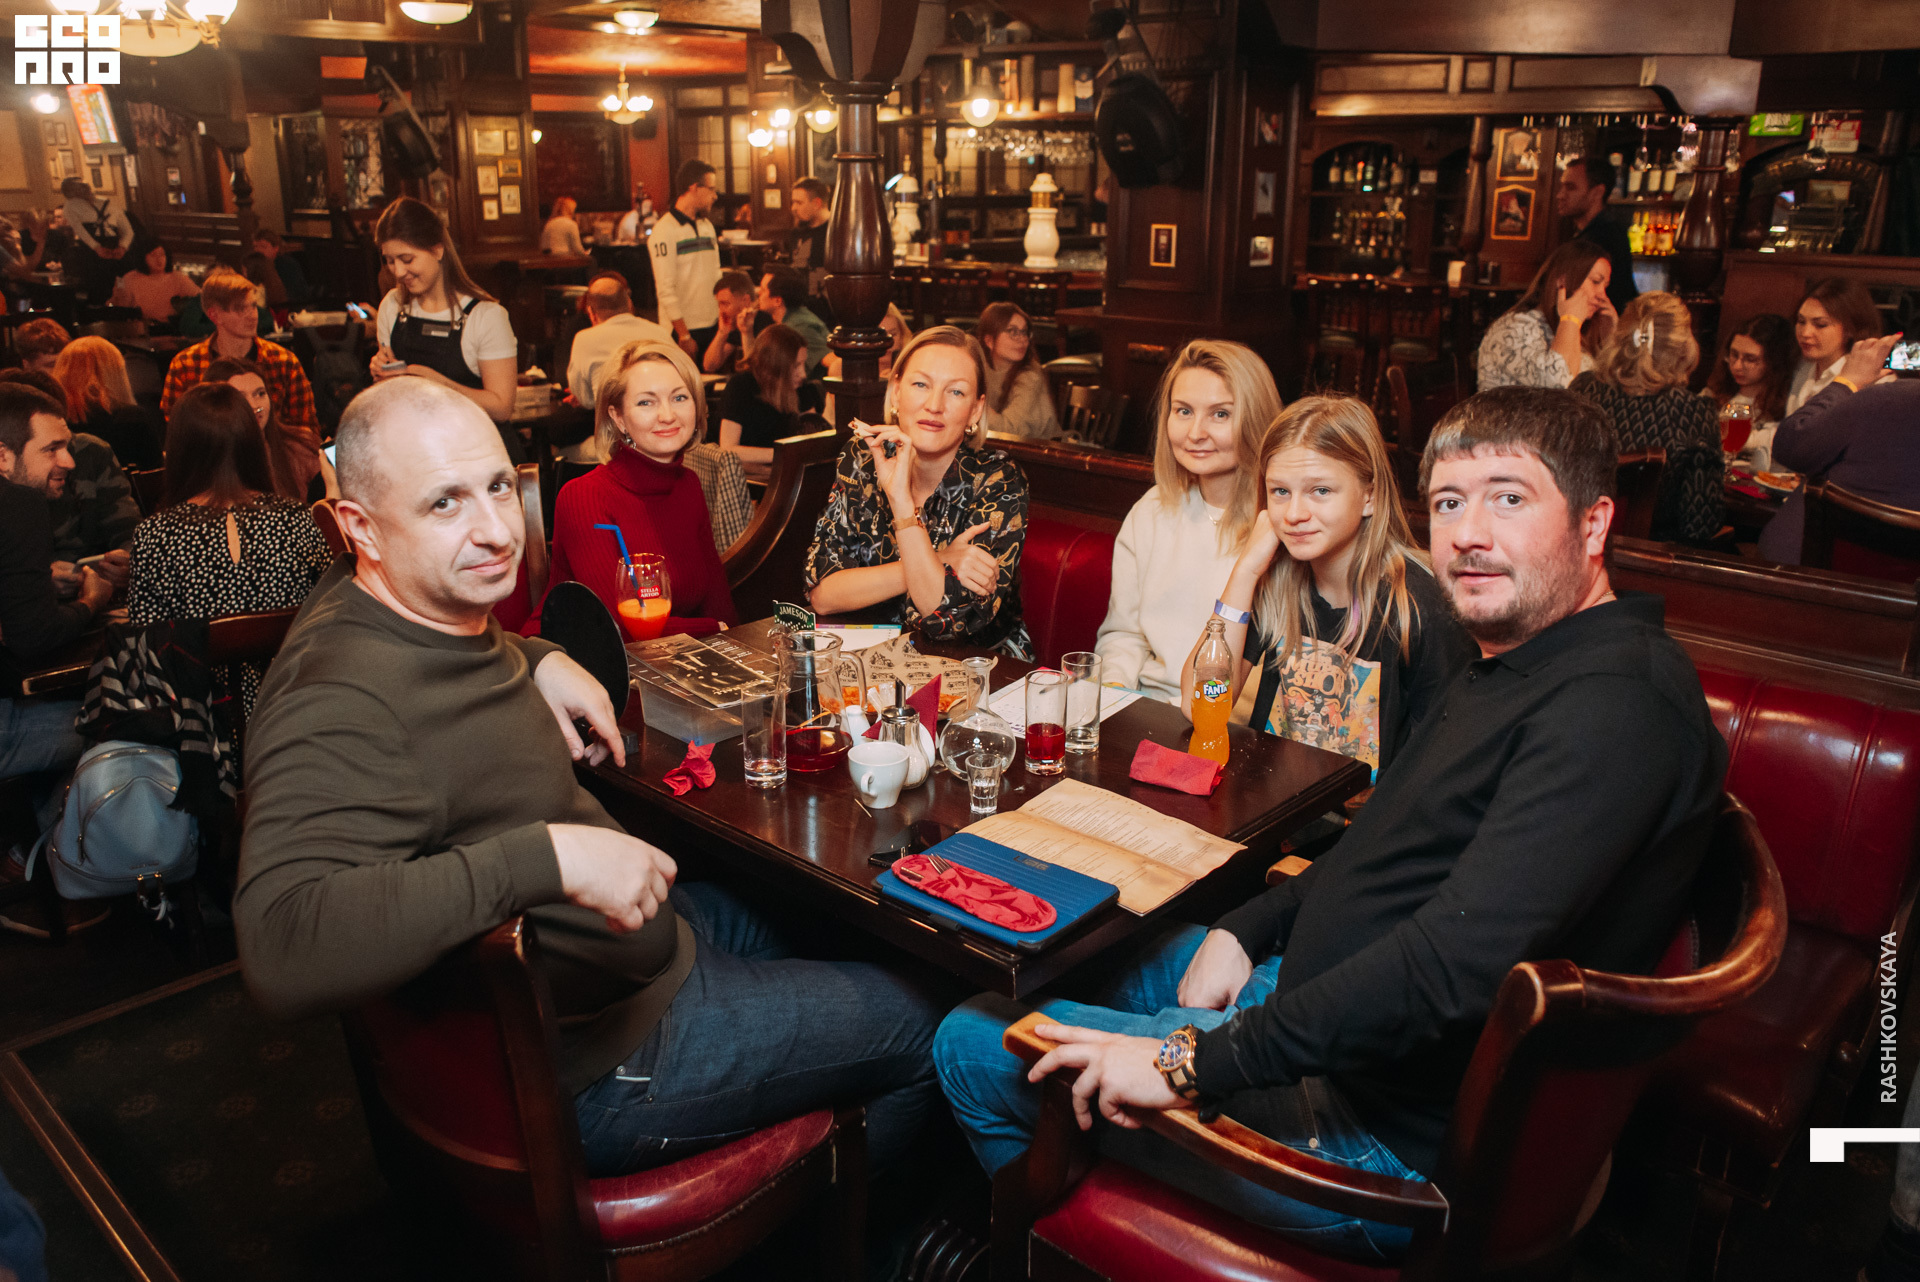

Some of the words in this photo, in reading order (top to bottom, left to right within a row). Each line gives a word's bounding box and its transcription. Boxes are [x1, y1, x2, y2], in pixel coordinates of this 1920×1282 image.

[654, 242, 668, 257] 10
[779, 606, 808, 622] JAMESON
[1203, 684, 1228, 695] FANTA
